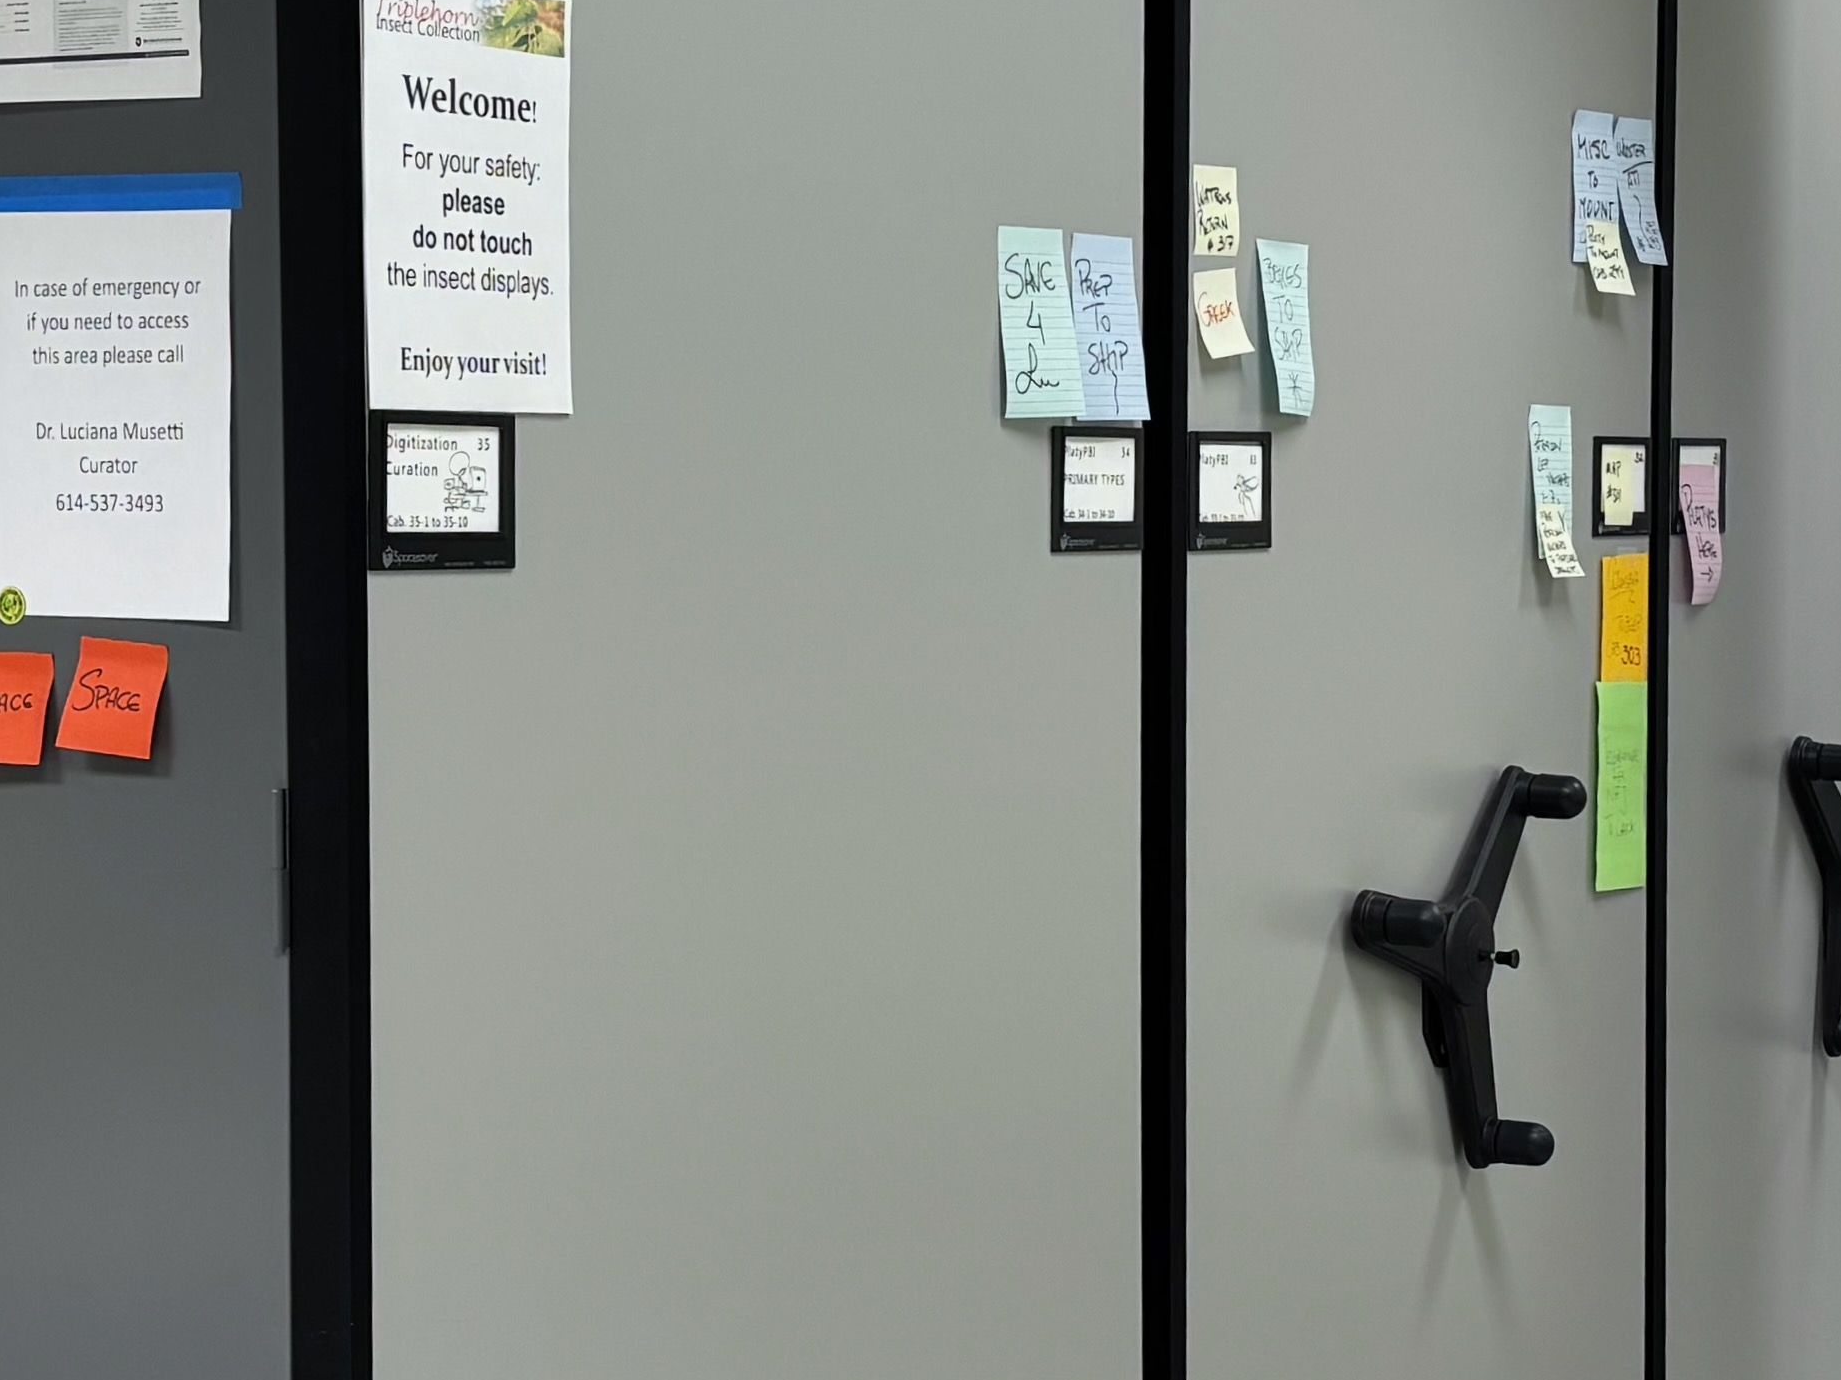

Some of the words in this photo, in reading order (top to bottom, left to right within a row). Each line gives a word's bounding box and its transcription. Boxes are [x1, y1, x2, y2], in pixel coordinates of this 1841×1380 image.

[376, 16, 413, 35] Insect
[417, 21, 480, 43] Collection
[402, 74, 537, 124] Welcome!
[1576, 133, 1611, 161] MISC
[402, 143, 434, 170] For
[439, 152, 480, 179] your
[485, 154, 541, 186] safety:
[442, 187, 505, 218] please
[1578, 197, 1615, 222] MOUNT
[412, 224, 437, 249] do
[443, 228, 475, 252] not
[480, 230, 533, 256] touch
[14, 280, 29, 298] In
[33, 281, 68, 297] case
[72, 277, 88, 296] of
[92, 279, 180, 300] emergency
[184, 279, 201, 295] or
[387, 261, 417, 288] the
[423, 263, 476, 291] insect
[480, 267, 554, 301] displays.
[1004, 252, 1056, 300] SAVE
[1074, 258, 1113, 299] PREP
[26, 312, 37, 331] if
[41, 316, 69, 335] you
[74, 311, 112, 330] need
[117, 313, 134, 330] to
[138, 314, 189, 330] access
[1026, 300, 1046, 346] 4
[32, 346, 60, 365] this
[64, 348, 98, 364] area
[102, 345, 153, 367] please
[157, 344, 184, 364] call
[400, 346, 453, 379] Enjoy
[457, 354, 500, 381] your
[503, 350, 547, 376] visit!
[36, 422, 55, 441] Dr.
[60, 422, 118, 441] Luciana
[122, 422, 184, 441] Musetti
[386, 433, 458, 454] Digitization
[477, 437, 491, 451] 35
[79, 456, 139, 474] Curator
[386, 460, 439, 477] Curation
[1064, 473, 1099, 486] PRIMARY
[1101, 473, 1125, 486] TYPES
[55, 493, 164, 513] 614-537-3493
[409, 515, 429, 528] 35-1
[432, 516, 441, 528] to
[444, 516, 469, 528] 35-10
[72, 668, 141, 712] SPACE
